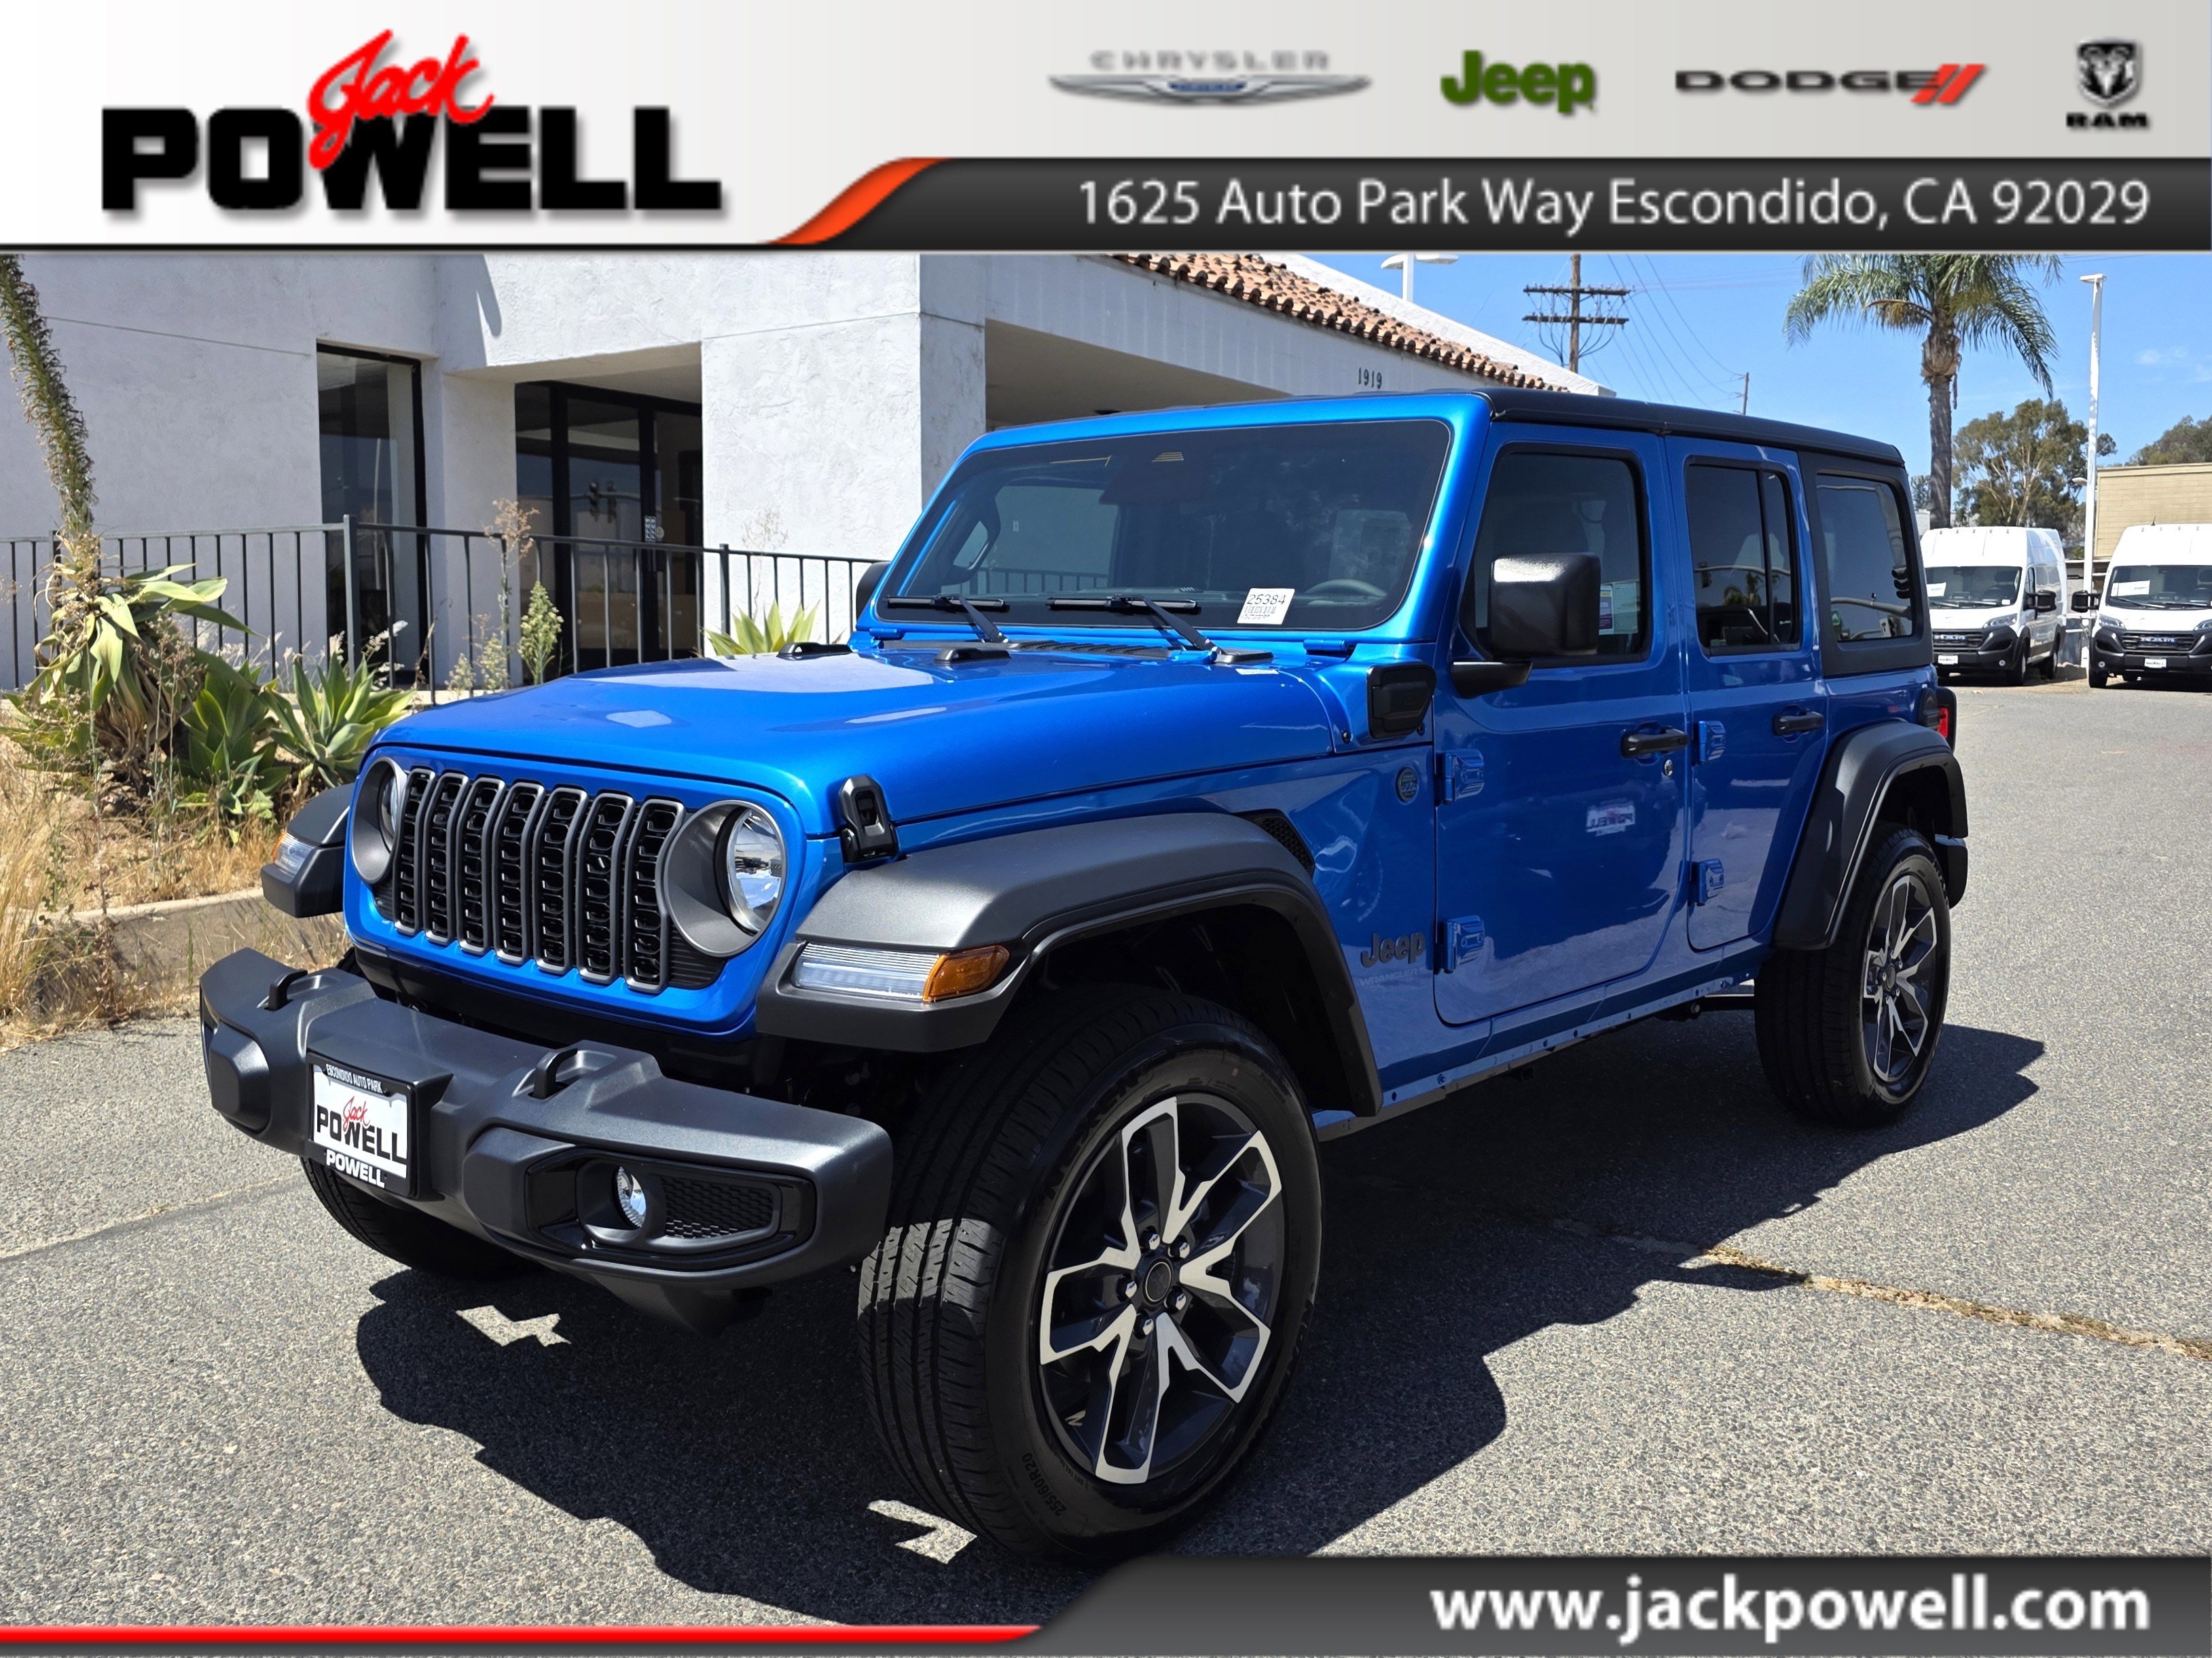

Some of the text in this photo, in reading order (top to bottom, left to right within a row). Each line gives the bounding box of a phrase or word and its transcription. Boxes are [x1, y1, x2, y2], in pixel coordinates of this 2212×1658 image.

[1358, 367, 1382, 390] 1919
[1247, 594, 1286, 604] 25384
[1361, 931, 1425, 968] Jeep
[326, 1063, 383, 1094] ESCONDIDO AUTO PARK
[343, 1096, 370, 1132] Jack
[317, 1104, 407, 1165] POWELL
[326, 1149, 385, 1188] POWELL
[1021, 1452, 1068, 1517] 255/60R20
